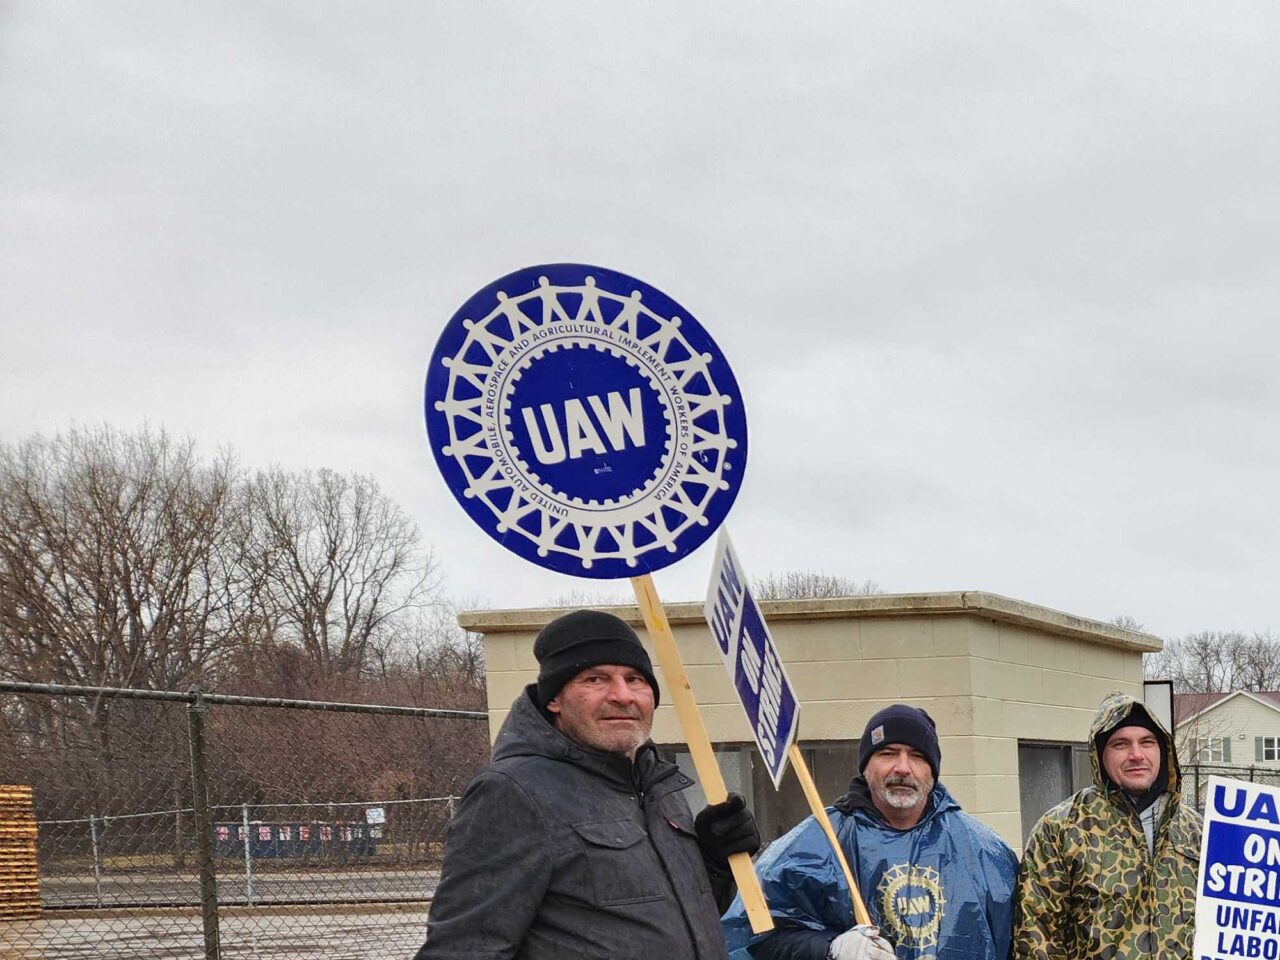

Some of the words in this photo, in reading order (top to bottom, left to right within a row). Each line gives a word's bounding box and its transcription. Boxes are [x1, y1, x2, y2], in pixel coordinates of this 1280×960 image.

[508, 338, 530, 359] AND
[532, 324, 614, 342] AGRICULTURAL
[618, 335, 671, 382] IMPLEMENT
[486, 358, 509, 419] AEROSPACE
[669, 385, 689, 438] WORKERS
[521, 387, 646, 465] UAW
[680, 442, 689, 457] OF
[487, 422, 530, 492] AUTOMOBILE,
[653, 460, 684, 501] AMERICA
[530, 492, 569, 517] UNITED
[711, 544, 742, 656] UAW
[740, 626, 762, 695] ON
[757, 637, 783, 768] STRIKE
[896, 895, 930, 916] UAW
